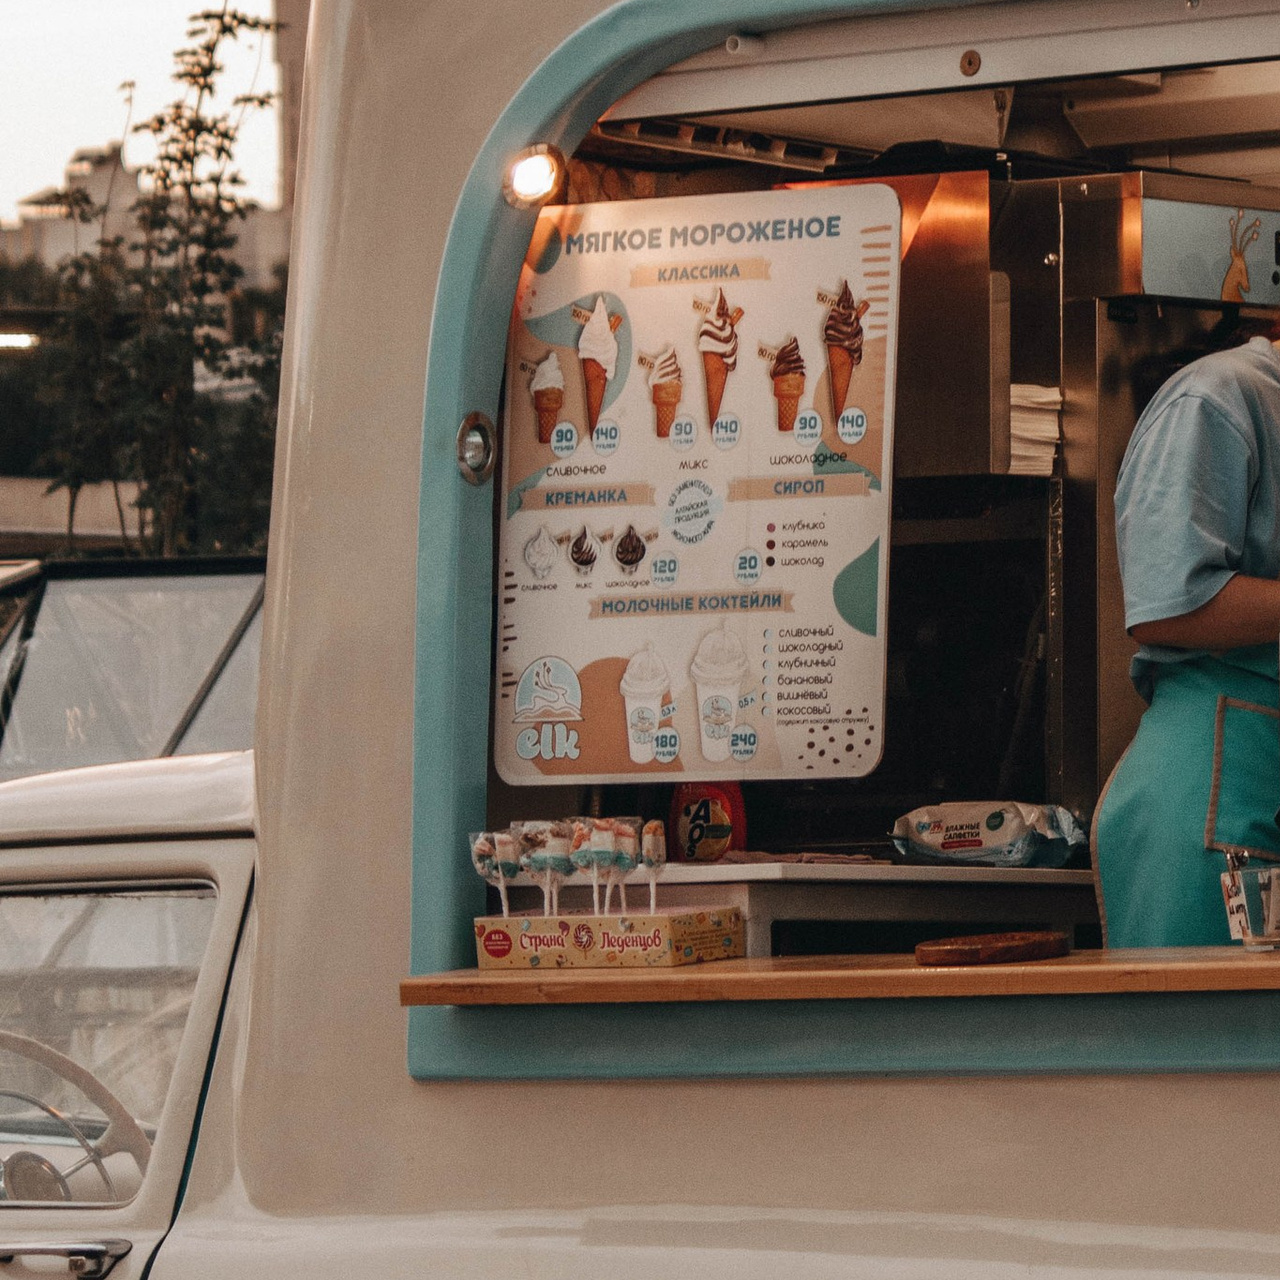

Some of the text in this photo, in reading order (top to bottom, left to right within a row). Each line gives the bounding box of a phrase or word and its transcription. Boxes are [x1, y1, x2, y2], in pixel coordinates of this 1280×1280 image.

[565, 215, 842, 255] МЯГКОЕ МОРОЖЕНОЕ
[657, 263, 741, 282] КЛАССИКА
[714, 421, 738, 434] 140
[798, 416, 818, 430] 90
[839, 414, 865, 428] 140
[555, 429, 574, 442] 90
[595, 427, 618, 440] 140
[674, 422, 693, 435] 90
[678, 459, 709, 470] микс
[769, 451, 848, 466] шоколадное
[546, 464, 607, 477] сливочное
[773, 480, 825, 495] СИРОП
[545, 489, 628, 506] КРЕМАНКА
[782, 520, 826, 533] клубника
[781, 539, 829, 550] карамель
[652, 559, 677, 574] 120
[738, 555, 758, 570] 20
[780, 556, 825, 567] шоколад
[605, 580, 651, 589] шоколадное
[601, 591, 782, 614] МОЛОЧНЫЕ КОКТЕЙЛИ
[779, 624, 834, 638] сливочный
[778, 639, 844, 654] шоколадный
[778, 655, 836, 670] клубничный
[777, 672, 833, 686] банановый
[777, 688, 828, 701] вишнёвый
[777, 703, 832, 716] кокосовый
[516, 721, 581, 760] elk
[654, 734, 678, 748] 180
[730, 733, 757, 747] 240
[943, 831, 980, 841] САЛФЕТКИ
[519, 932, 566, 954] Страна
[599, 928, 662, 954] Леденцов
